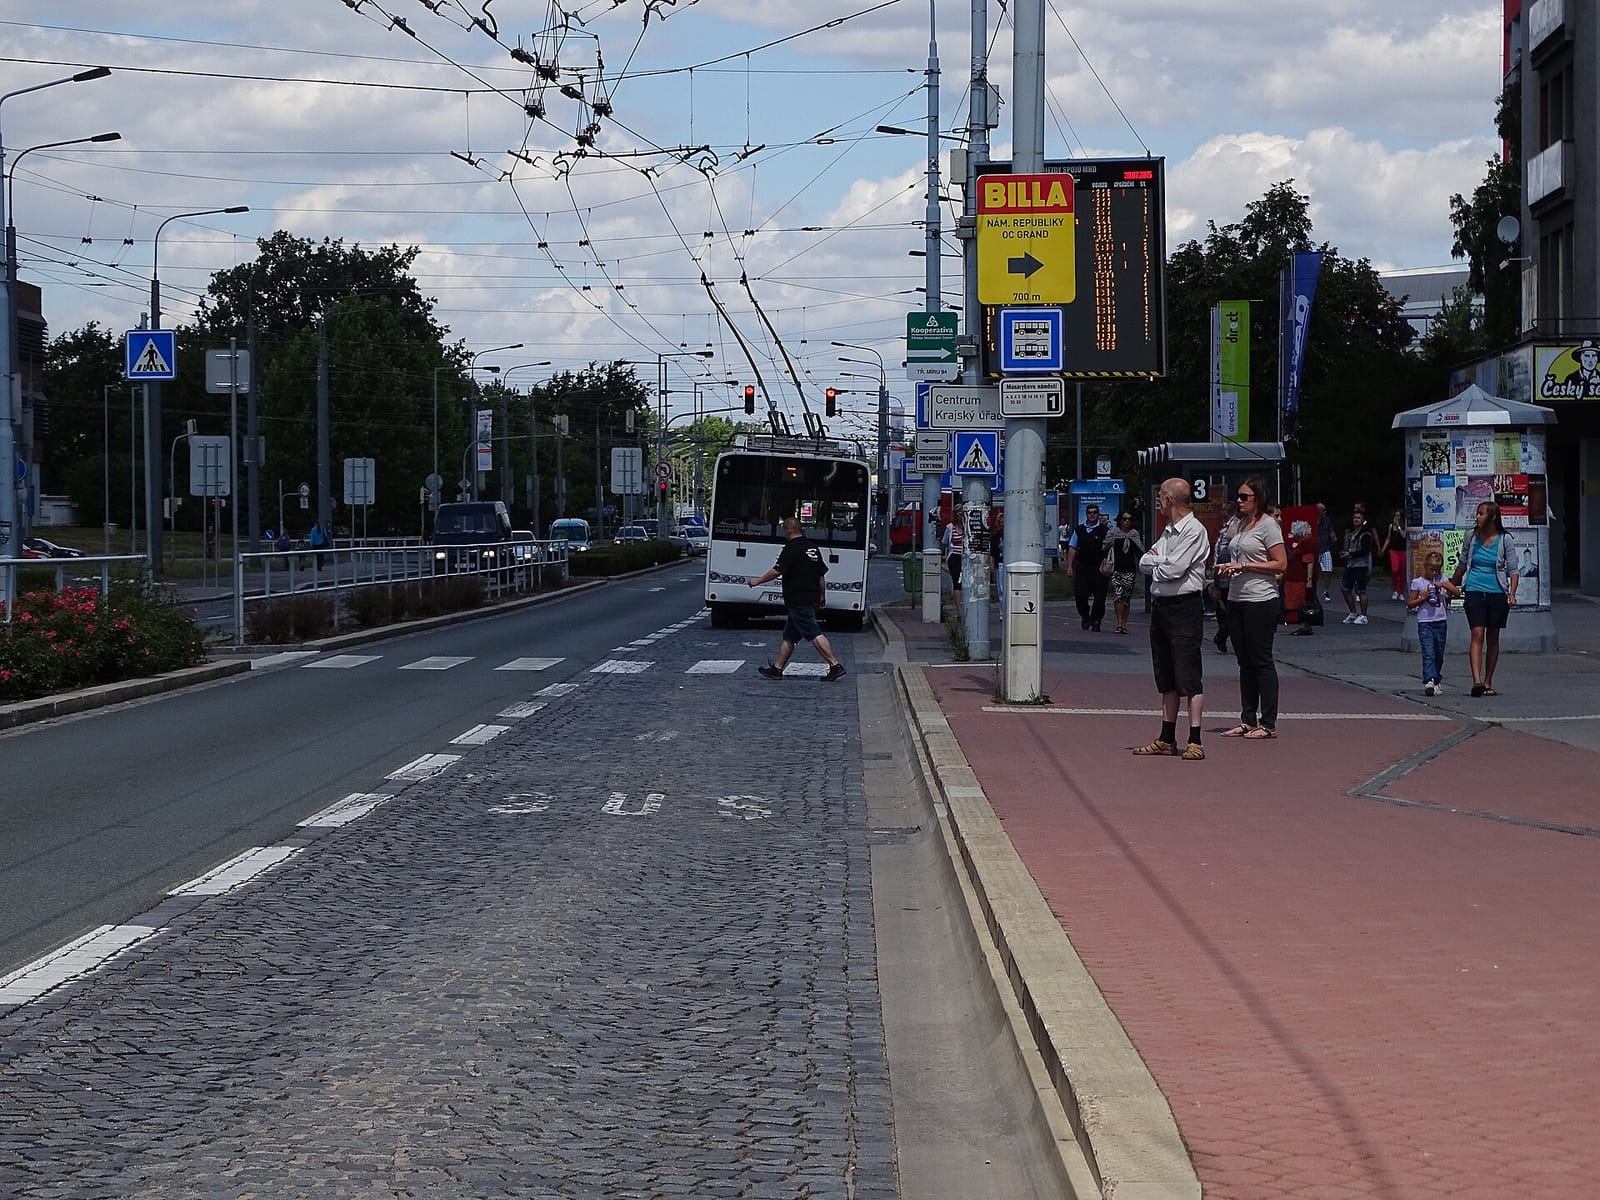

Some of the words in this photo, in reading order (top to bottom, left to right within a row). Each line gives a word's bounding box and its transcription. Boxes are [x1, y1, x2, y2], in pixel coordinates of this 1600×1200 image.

[984, 181, 1068, 208] BILLA
[987, 216, 1010, 228] NÁM.
[1013, 218, 1064, 227] REPUBLIKY
[1002, 231, 1014, 239] OC
[1017, 230, 1049, 239] GRAND
[1013, 293, 1029, 301] 700
[911, 326, 954, 334] Kooperativa
[1226, 311, 1239, 343] direct
[1543, 376, 1584, 400] Český
[935, 394, 982, 405] Centrum
[1049, 395, 1056, 409] 1
[935, 409, 975, 422] Krajský
[1228, 401, 1236, 432] direct.cz
[1193, 479, 1206, 499] 3
[487, 791, 772, 820] BUS
